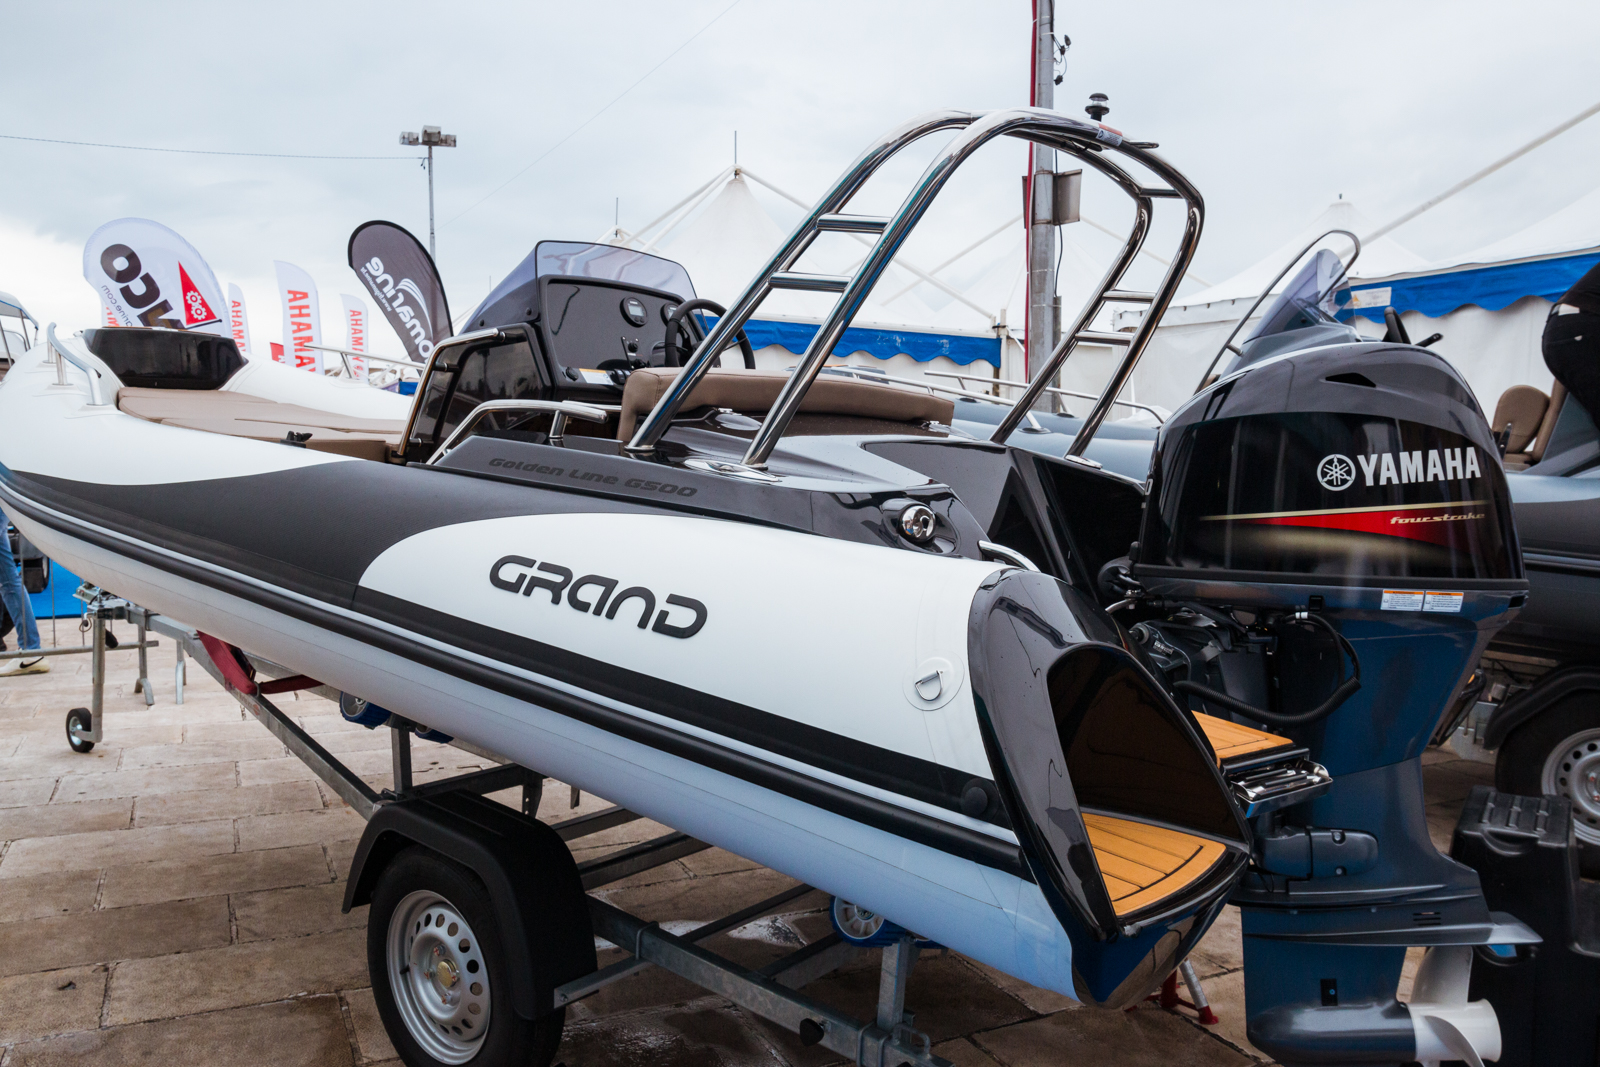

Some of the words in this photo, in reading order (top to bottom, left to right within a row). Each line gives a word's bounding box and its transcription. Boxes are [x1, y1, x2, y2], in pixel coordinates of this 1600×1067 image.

[488, 457, 564, 476] Golden
[624, 478, 698, 497] G500
[1357, 446, 1481, 487] YAMAHA
[489, 554, 708, 639] GRAND
